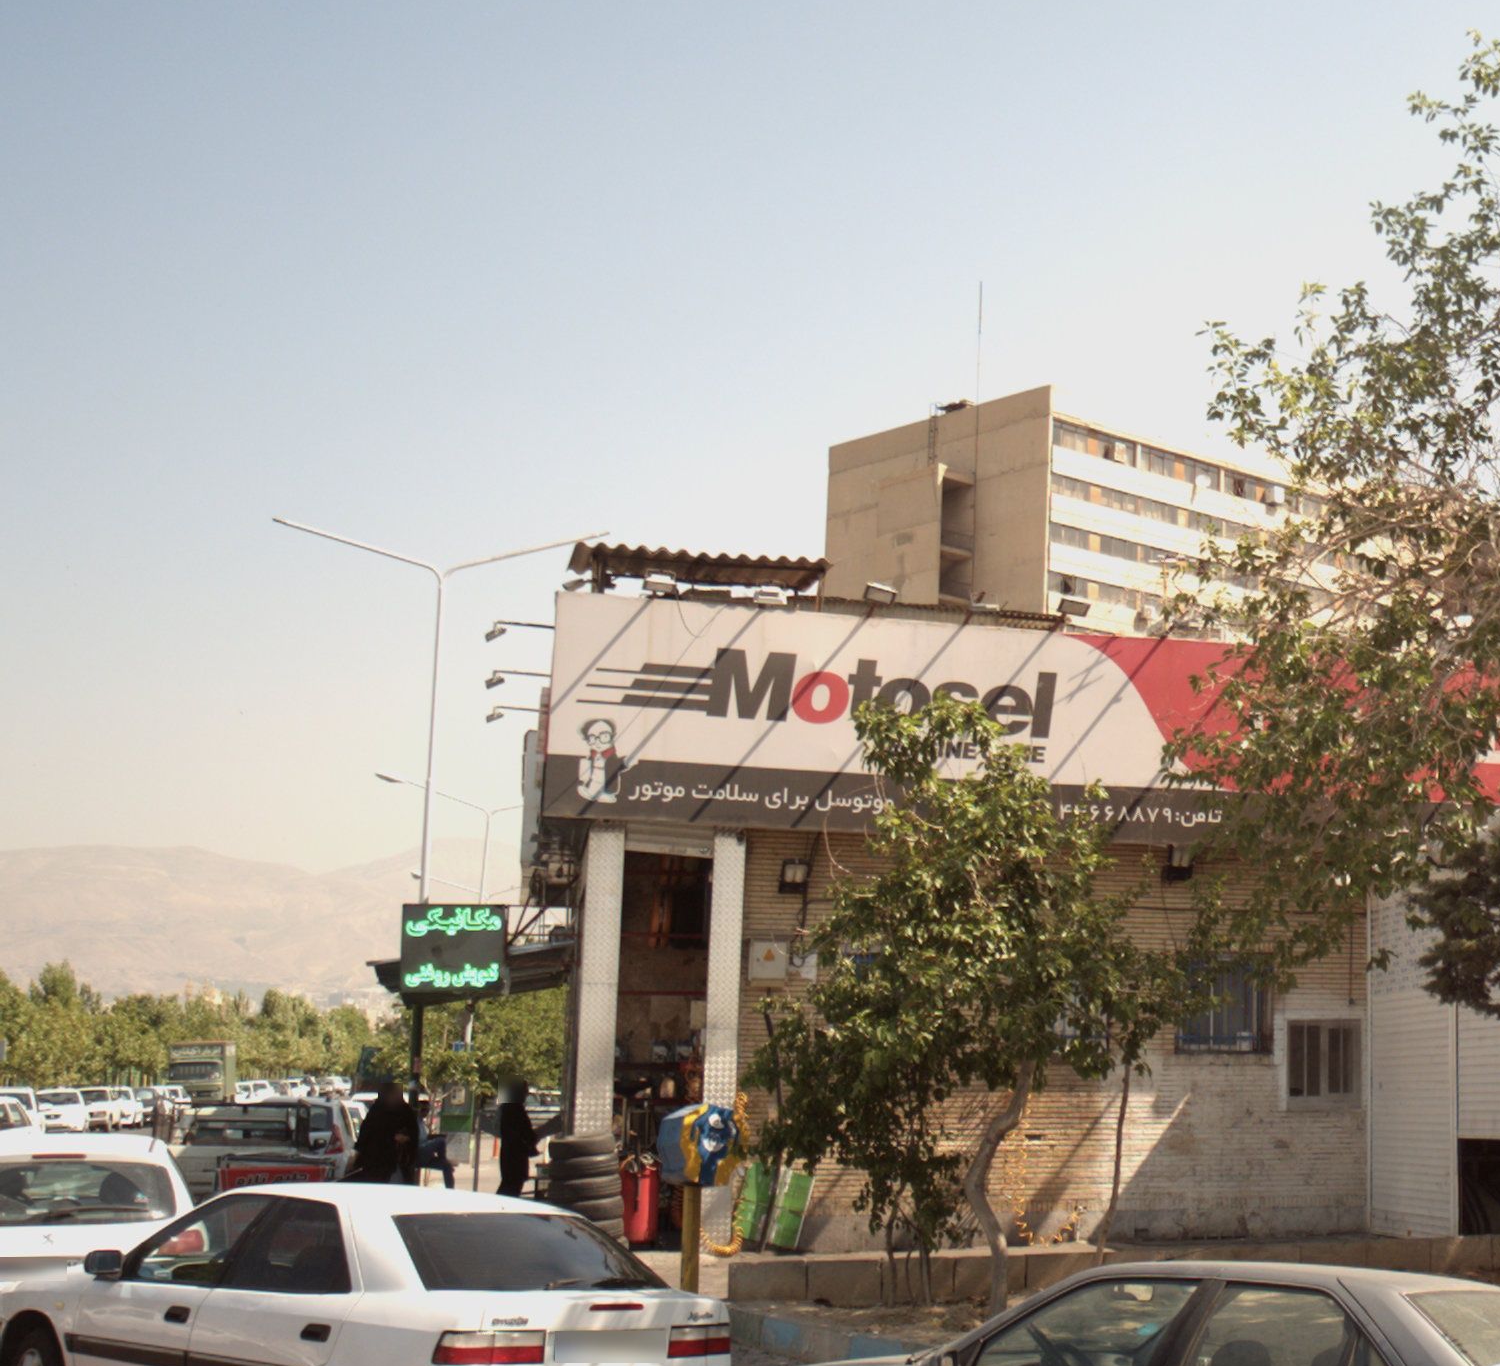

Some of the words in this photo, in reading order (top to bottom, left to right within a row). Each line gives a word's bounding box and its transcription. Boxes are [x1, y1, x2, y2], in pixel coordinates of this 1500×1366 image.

[705, 647, 1058, 739] Motosel
[628, 781, 687, 803] موتور
[691, 782, 760, 803] سلامت
[764, 787, 810, 810] برای
[814, 789, 895, 815] موتوسل
[405, 907, 502, 937] مکانیکی
[404, 963, 451, 988] روغنی
[451, 963, 500, 988] تعویض
